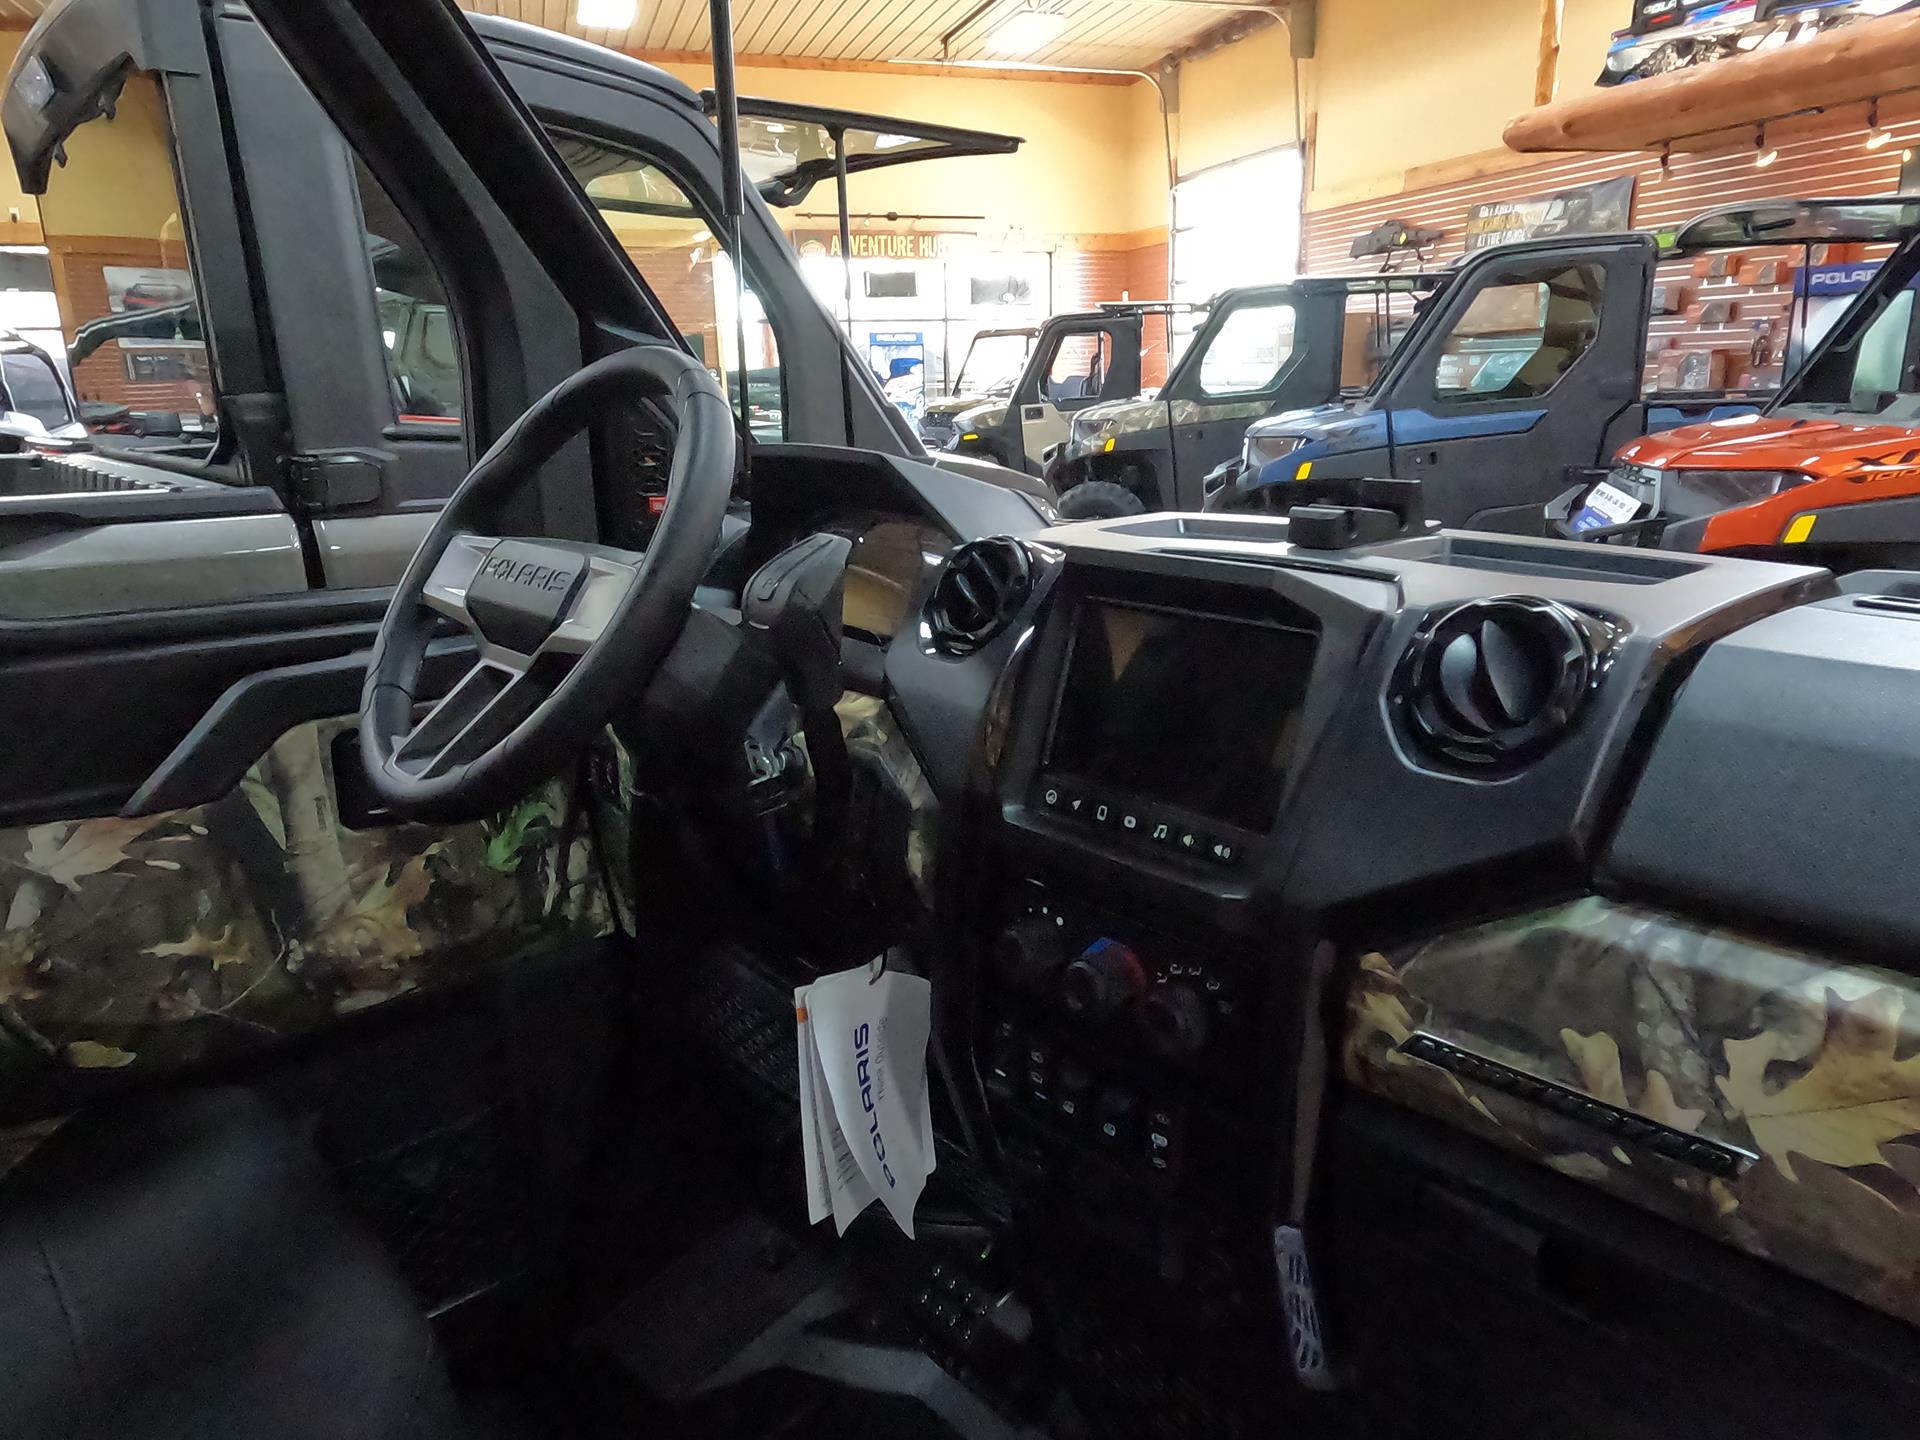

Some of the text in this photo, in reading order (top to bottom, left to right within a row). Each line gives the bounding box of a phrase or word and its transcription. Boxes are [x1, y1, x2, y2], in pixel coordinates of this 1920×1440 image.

[830, 234, 915, 257] AVENTURE
[480, 556, 571, 592] POLARIS
[854, 1022, 897, 1188] POLARIS
